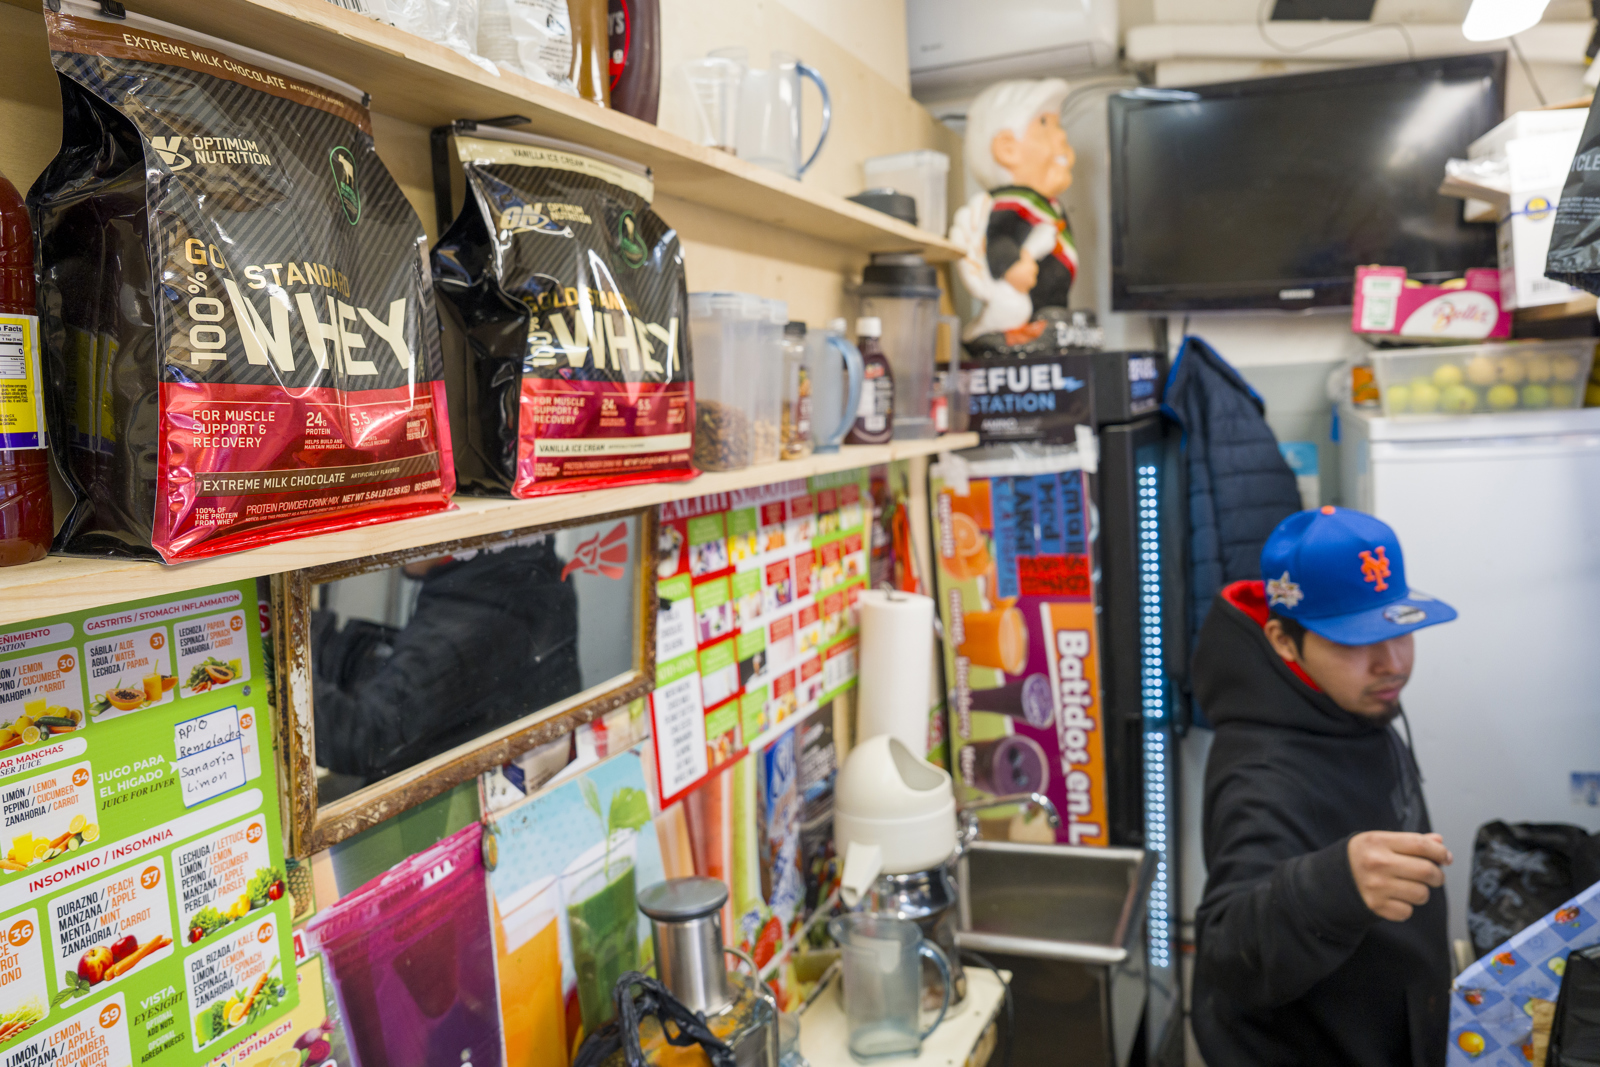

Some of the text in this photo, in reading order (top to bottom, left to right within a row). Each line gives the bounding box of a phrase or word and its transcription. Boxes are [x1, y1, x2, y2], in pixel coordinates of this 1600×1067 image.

[122, 33, 287, 90] EXTREME MILK CHOCOLATE
[192, 136, 259, 153] OPTIMUM
[512, 148, 544, 160] VANILLA
[194, 150, 272, 166] NUTRITION
[244, 261, 350, 298] STANDARD
[188, 271, 228, 365] 100%
[224, 278, 410, 376] WHEY
[548, 309, 681, 374] WHEY
[967, 363, 1066, 394] EFUEL
[533, 396, 586, 407] FOR MUSCLE
[533, 406, 572, 415] SUPPORT
[192, 410, 276, 422] FOR MUSCLE
[533, 414, 577, 425] RECOVERY
[192, 424, 266, 435] SUPPORT &
[193, 437, 262, 448] RECOVERY
[540, 444, 570, 453] VANILLA
[571, 444, 581, 452] ICE
[584, 444, 606, 452] CREAM
[203, 467, 400, 492] EXTREME MILK CHOCOLATE ARTIFICIALLY FLAVORED
[246, 503, 278, 515] PROTEIN
[278, 500, 308, 512] POWDER
[308, 497, 328, 508] DRINK
[328, 496, 340, 506] MIX
[342, 492, 355, 503] NET
[355, 492, 365, 501] WT
[365, 490, 378, 500] 5.64
[378, 488, 386, 497] LB
[87, 594, 240, 631] GASTRITIS STOMACH INFLAMMATION
[232, 619, 243, 628] 32
[179, 620, 225, 637] LECHOZA PAPAYA
[180, 628, 230, 647] ESPINACA SPINACH
[90, 640, 134, 657] SÁBILA ALOE
[152, 637, 163, 646] 31
[181, 637, 233, 657] ZANAHORIA CARROT
[18, 662, 43, 675] LEMON
[60, 658, 74, 669] 30
[92, 650, 135, 667] AGUA WATER
[92, 657, 149, 678] LECHOZA PAPAYA
[22, 670, 61, 686] CUCUMBER
[1056, 628, 1093, 766] Batidos
[16, 745, 64, 764] MANCHAS
[18, 759, 42, 772] JUICE
[74, 772, 88, 784] 34
[98, 755, 165, 784] JUGO PARA
[2, 778, 57, 803] LIMÓN LEMON
[100, 769, 163, 798] EL HIGADO
[102, 778, 175, 811] JUICE FOR LIVER
[4, 784, 74, 815] PEPINO CUCUMBER
[5, 794, 79, 827] ZANAHORIA CARROT
[248, 826, 261, 841] 38
[179, 830, 245, 866] LECHUGA LETTUCE
[209, 847, 232, 865] LEMON
[29, 829, 173, 892] INSOMNIO INSOMNIA
[181, 852, 249, 890] PEPINO CUCUMBER
[143, 870, 158, 885] 37
[183, 865, 244, 901] MANZANA APPLE
[218, 876, 246, 898] PARSLEY
[57, 877, 134, 919] DURAZNO PEACH
[59, 888, 137, 932] MANZANA APPLE
[11, 924, 32, 943] 36
[60, 908, 120, 945] MENTA MINT
[62, 907, 151, 958] ZANAHORIA CARROT
[259, 926, 272, 939] 40
[191, 931, 254, 972] COL RIZADA KALE
[222, 948, 245, 969] LEMON
[194, 951, 262, 996] ESPINACA SPINACH
[195, 960, 265, 1008] ZANAHORIA CARROT
[134, 990, 184, 1026] EYESIGHT
[140, 985, 176, 1009] VISTA
[102, 1008, 119, 1026] 39
[148, 1016, 174, 1038] ADD NUTS
[6, 1021, 81, 1067] LIMÓN LEMON
[68, 1026, 96, 1051] APPLE
[141, 1032, 185, 1064] AGREGA NUECES
[239, 1021, 292, 1061] SPINACH
[56, 1035, 106, 1067] CUCUMBER
[80, 1046, 109, 1067] WIDER
